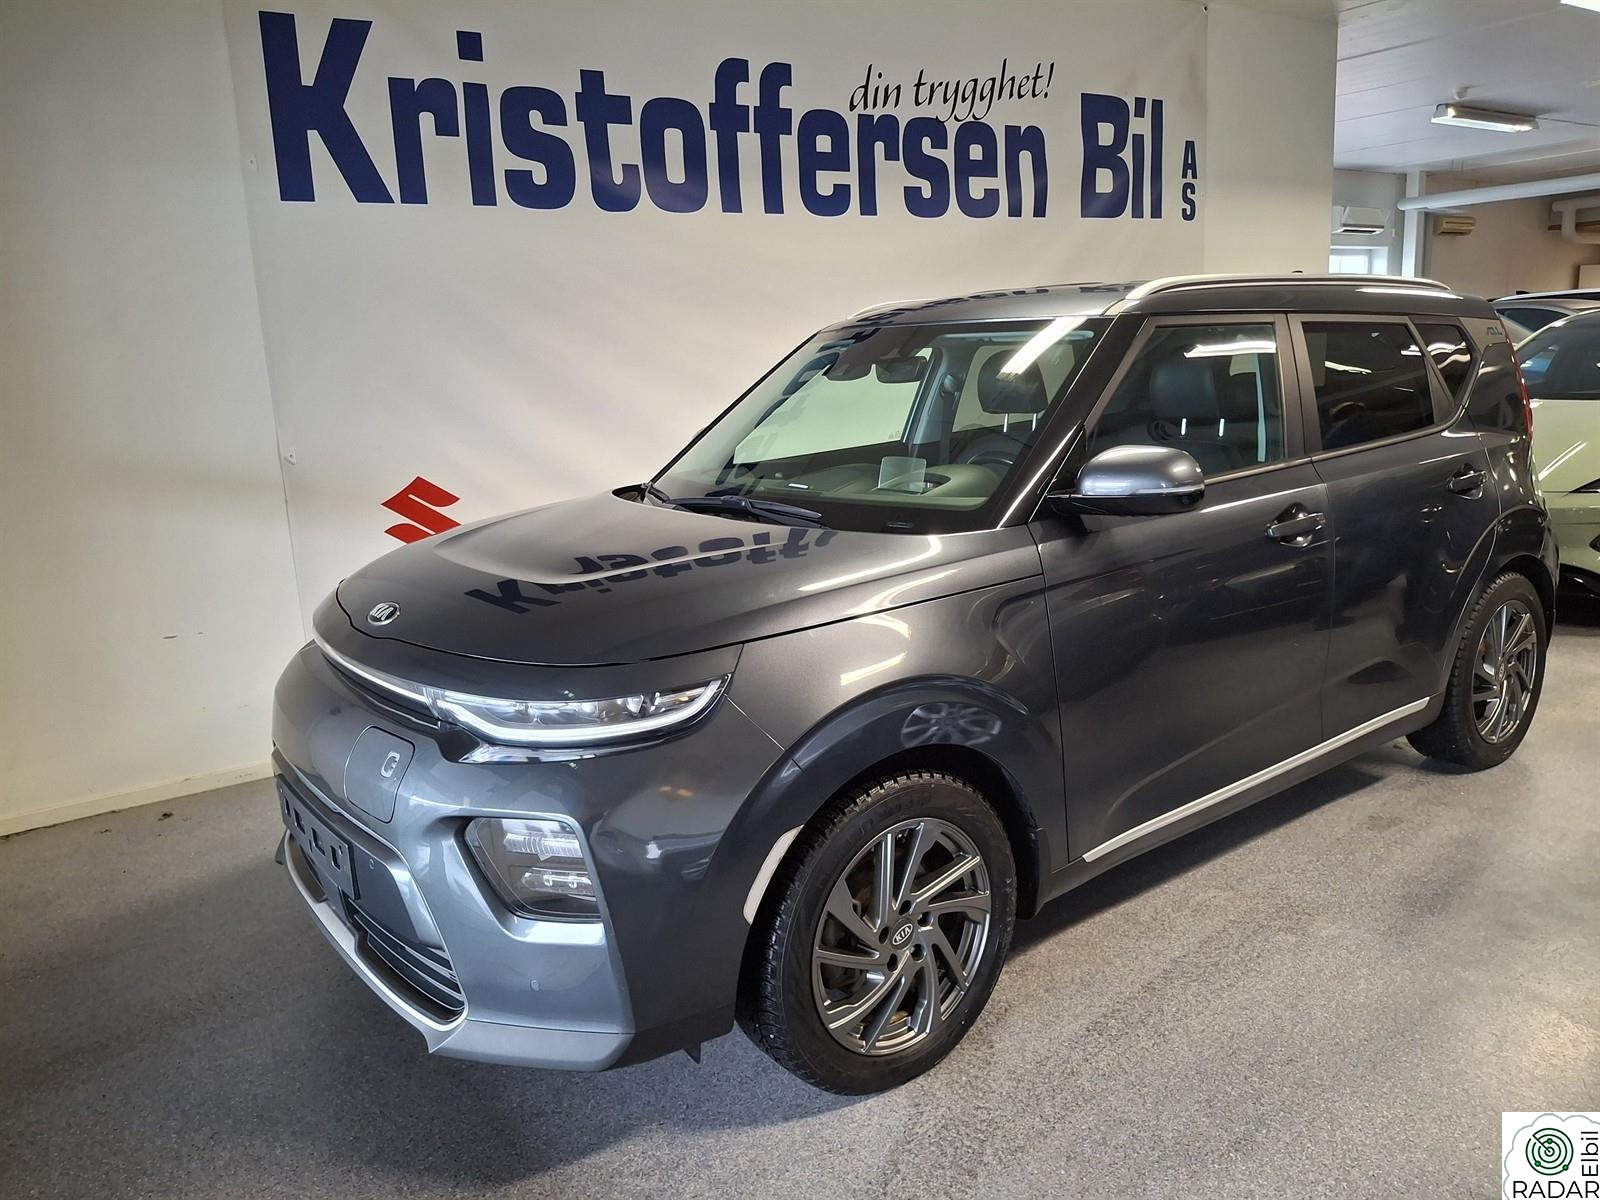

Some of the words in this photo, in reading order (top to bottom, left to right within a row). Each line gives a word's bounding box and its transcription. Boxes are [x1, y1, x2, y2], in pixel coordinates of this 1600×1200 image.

[259, 10, 1048, 218] Kristoffersen
[1081, 93, 1163, 218] Bil
[849, 64, 901, 112] din
[913, 58, 1055, 122] trygghet!
